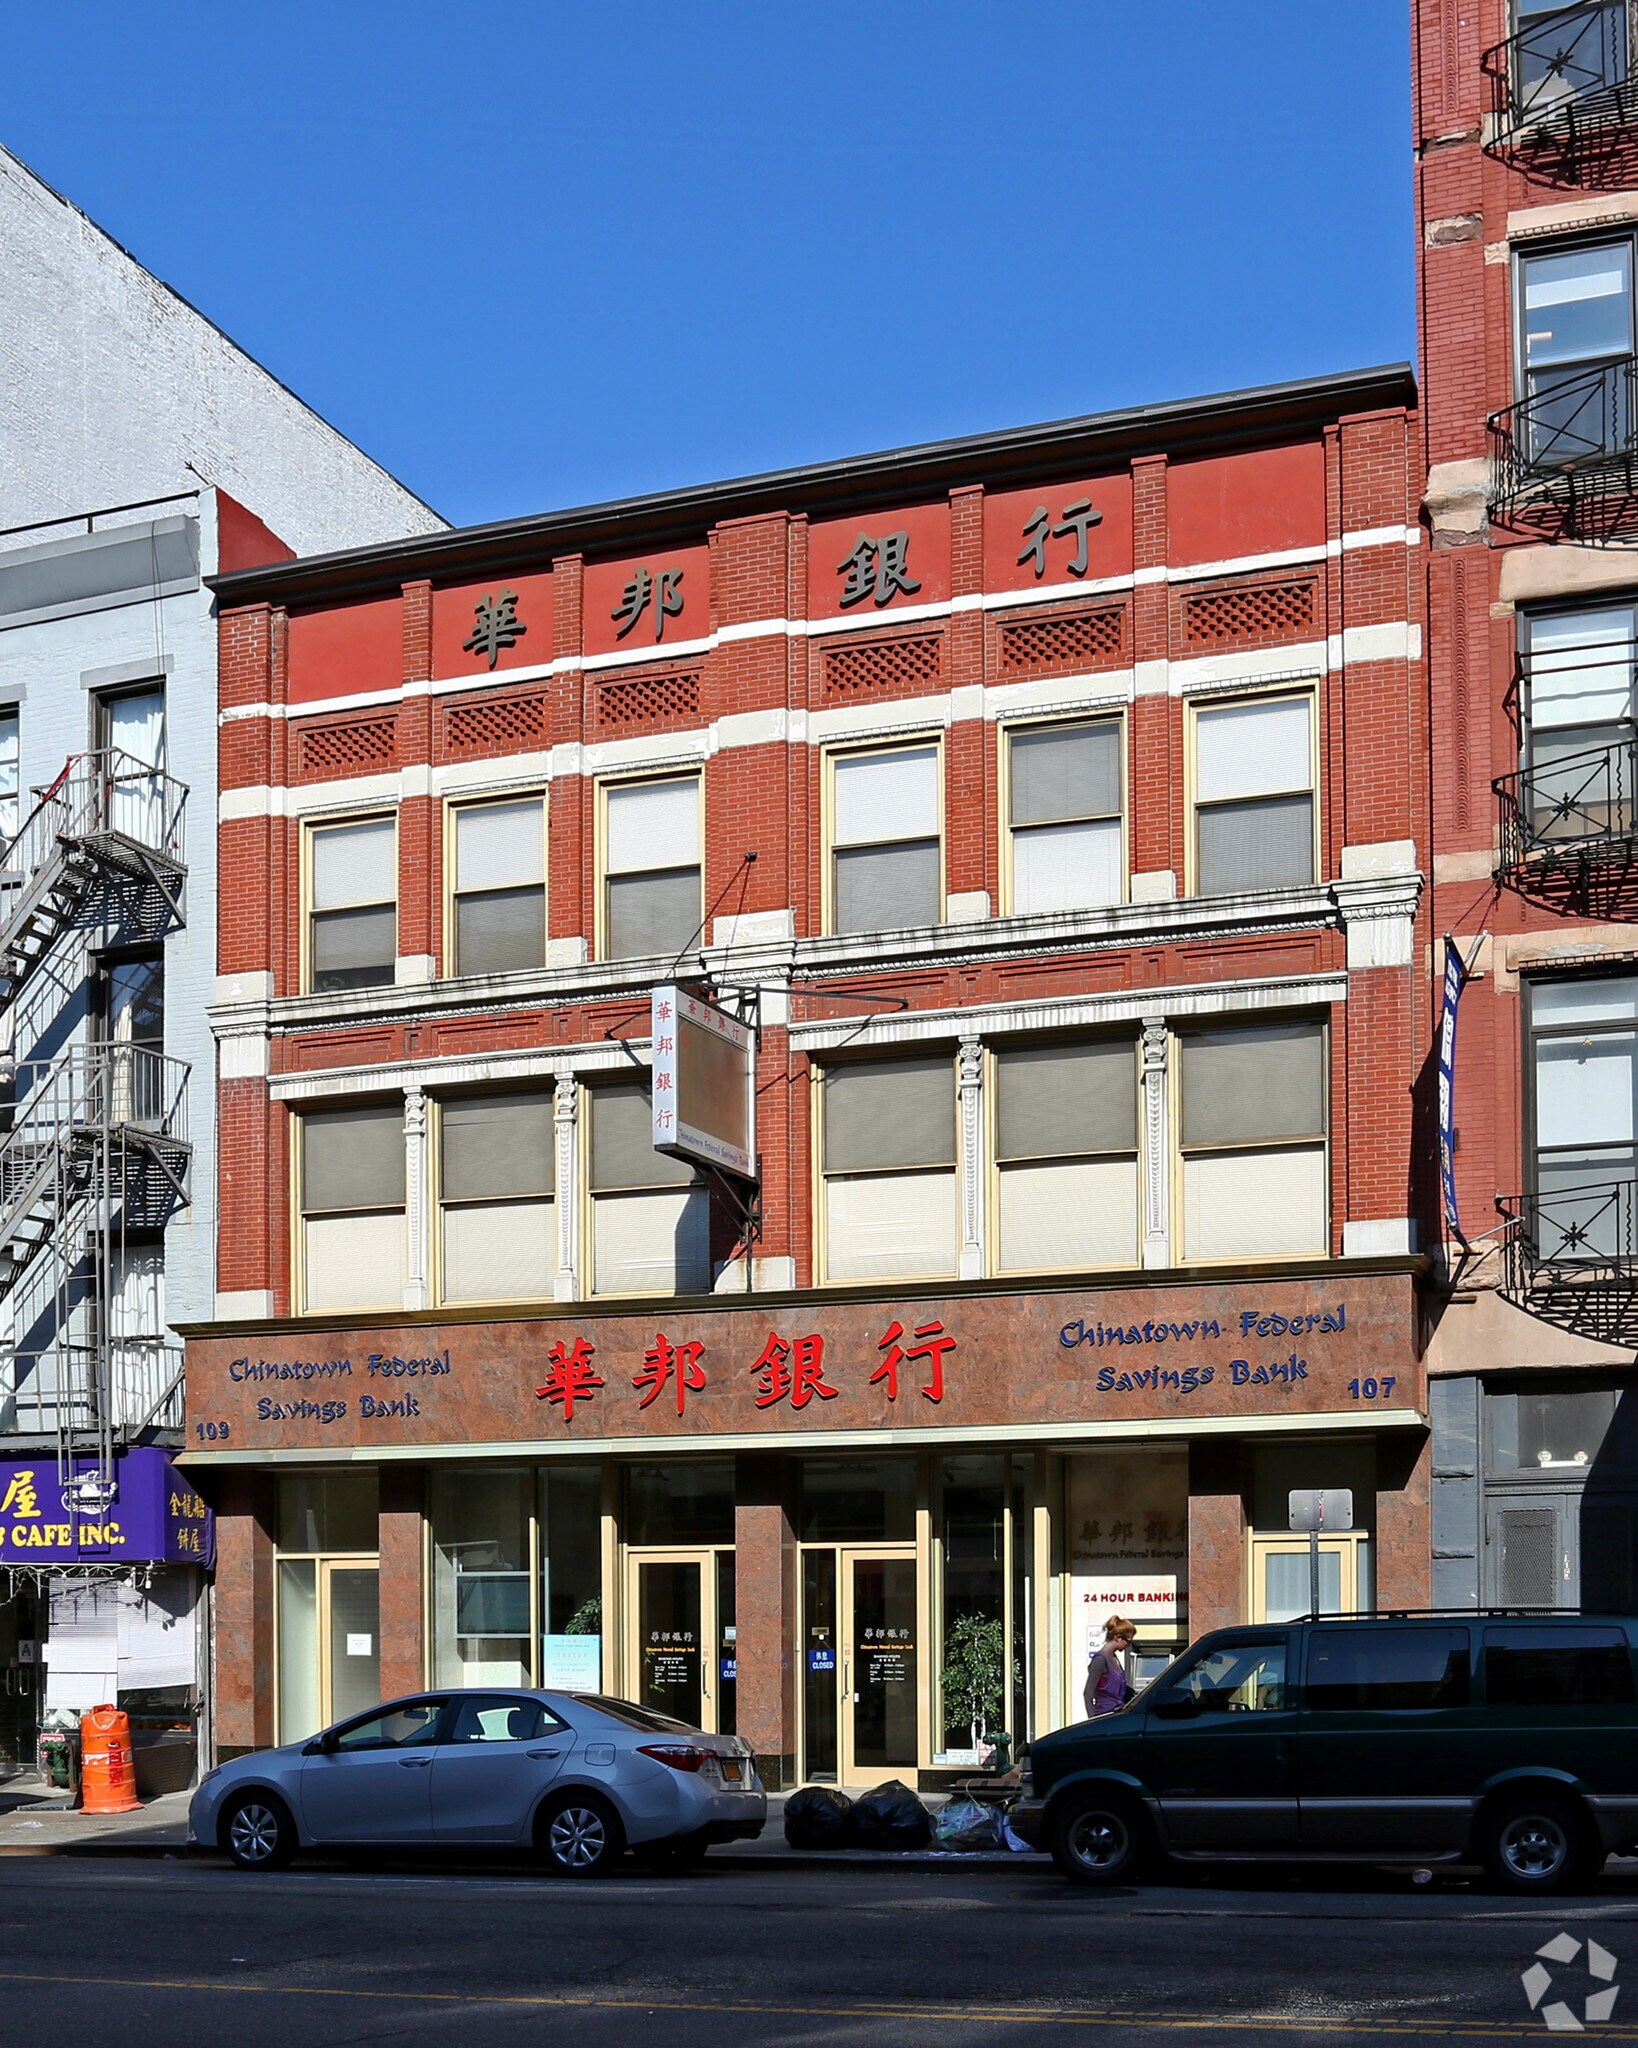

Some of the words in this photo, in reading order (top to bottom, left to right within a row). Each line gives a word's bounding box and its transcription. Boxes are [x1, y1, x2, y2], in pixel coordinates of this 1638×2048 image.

[463, 498, 1103, 669] 華邦銀行
[688, 1000, 740, 1041] 華邦銀行
[656, 1001, 674, 1129] 華邦銀行
[1059, 1317, 1221, 1349] Chinatown
[1238, 1304, 1346, 1337] Federal
[229, 1356, 352, 1384] Chinatown
[367, 1350, 451, 1377] Federal
[536, 1320, 956, 1421] 華邦銀行
[1096, 1364, 1215, 1394] Savings
[1231, 1354, 1309, 1386] Bank
[1347, 1376, 1396, 1399] 107
[256, 1397, 347, 1424] Savings
[358, 1392, 420, 1419] Bank
[196, 1421, 229, 1441] 109
[0, 1470, 42, 1519] 屋
[11, 1524, 74, 1547] CAFE
[78, 1521, 126, 1546] INC.
[1083, 1593, 1098, 1603] 24
[1100, 1593, 1135, 1603] HOUR
[21, 1643, 32, 1657] A
[812, 1661, 834, 1670] CLOSED
